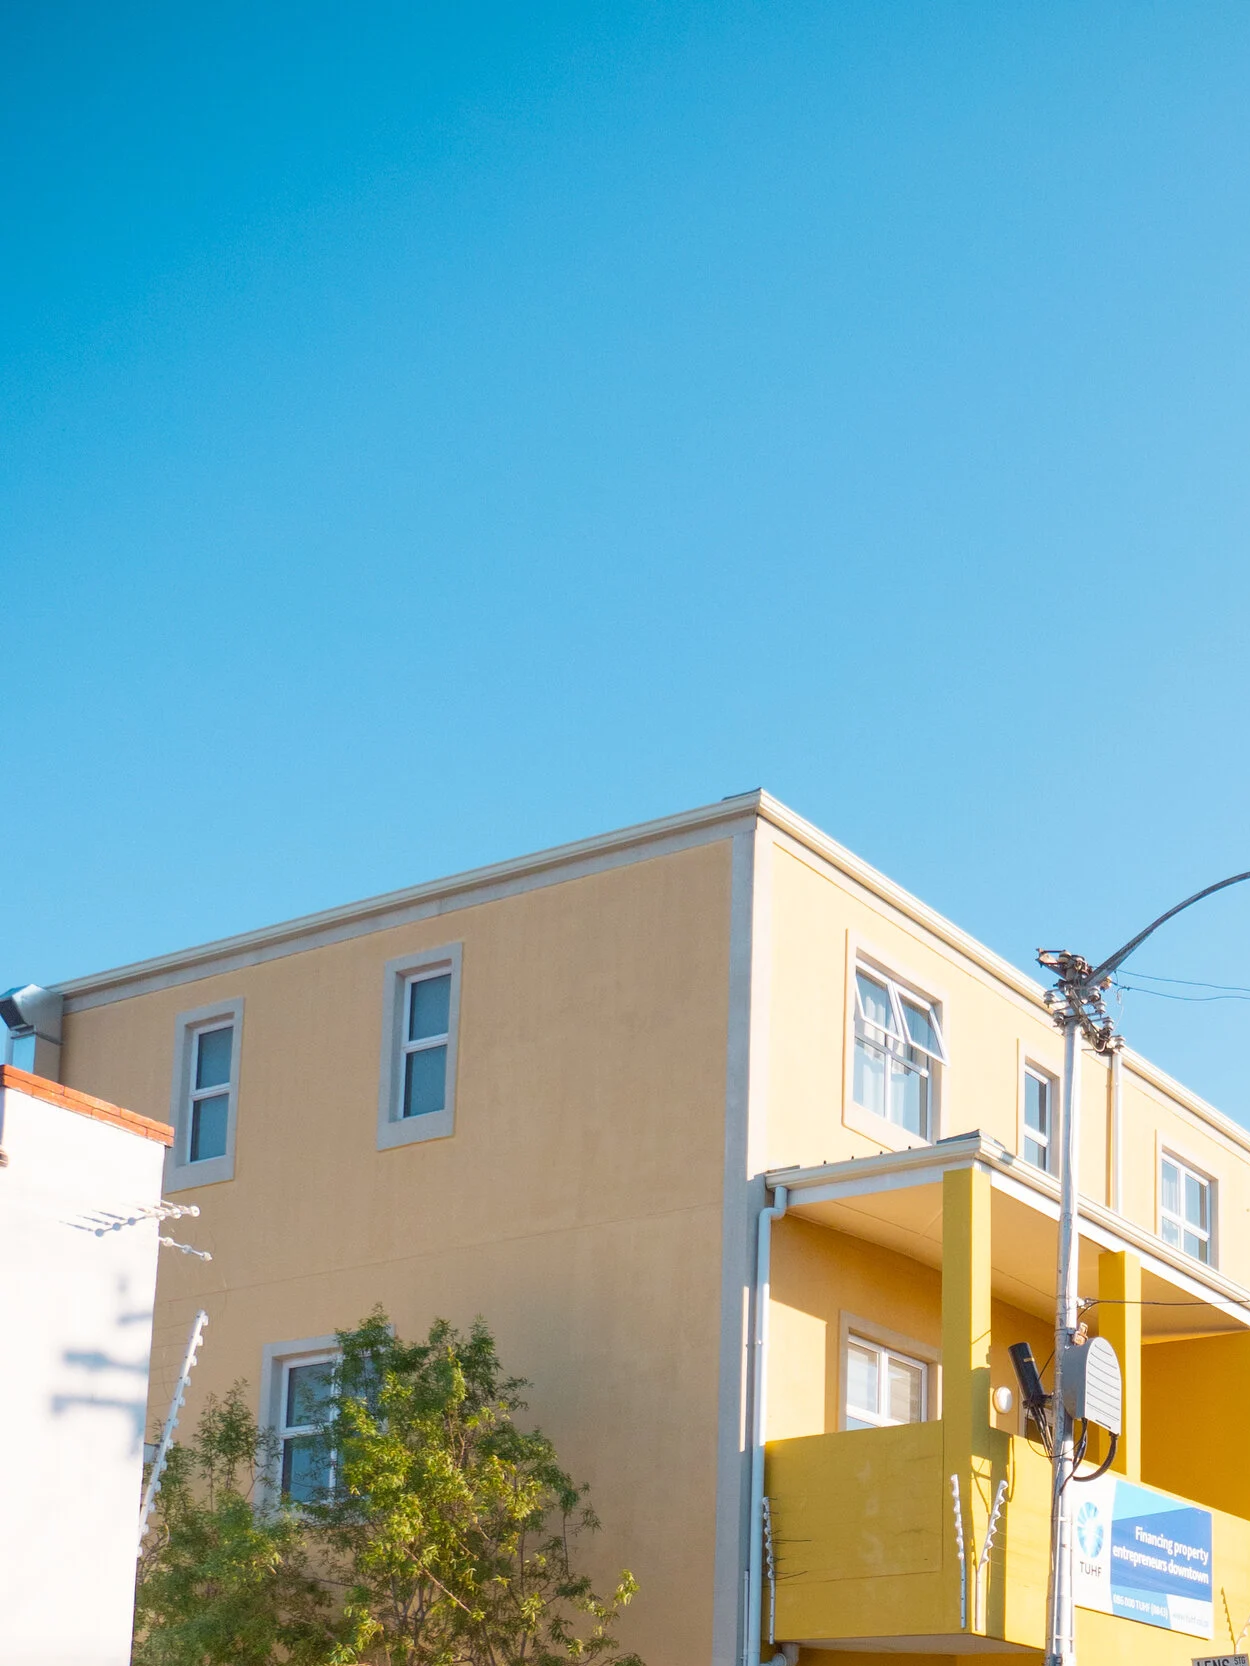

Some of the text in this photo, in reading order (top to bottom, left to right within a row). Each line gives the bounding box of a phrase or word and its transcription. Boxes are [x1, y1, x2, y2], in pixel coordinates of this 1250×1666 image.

[1135, 1526, 1209, 1565] Financing property
[1080, 1561, 1102, 1577] TUHF
[1112, 1545, 1209, 1584] entrepreneurs downtown
[1234, 1656, 1246, 1665] STG
